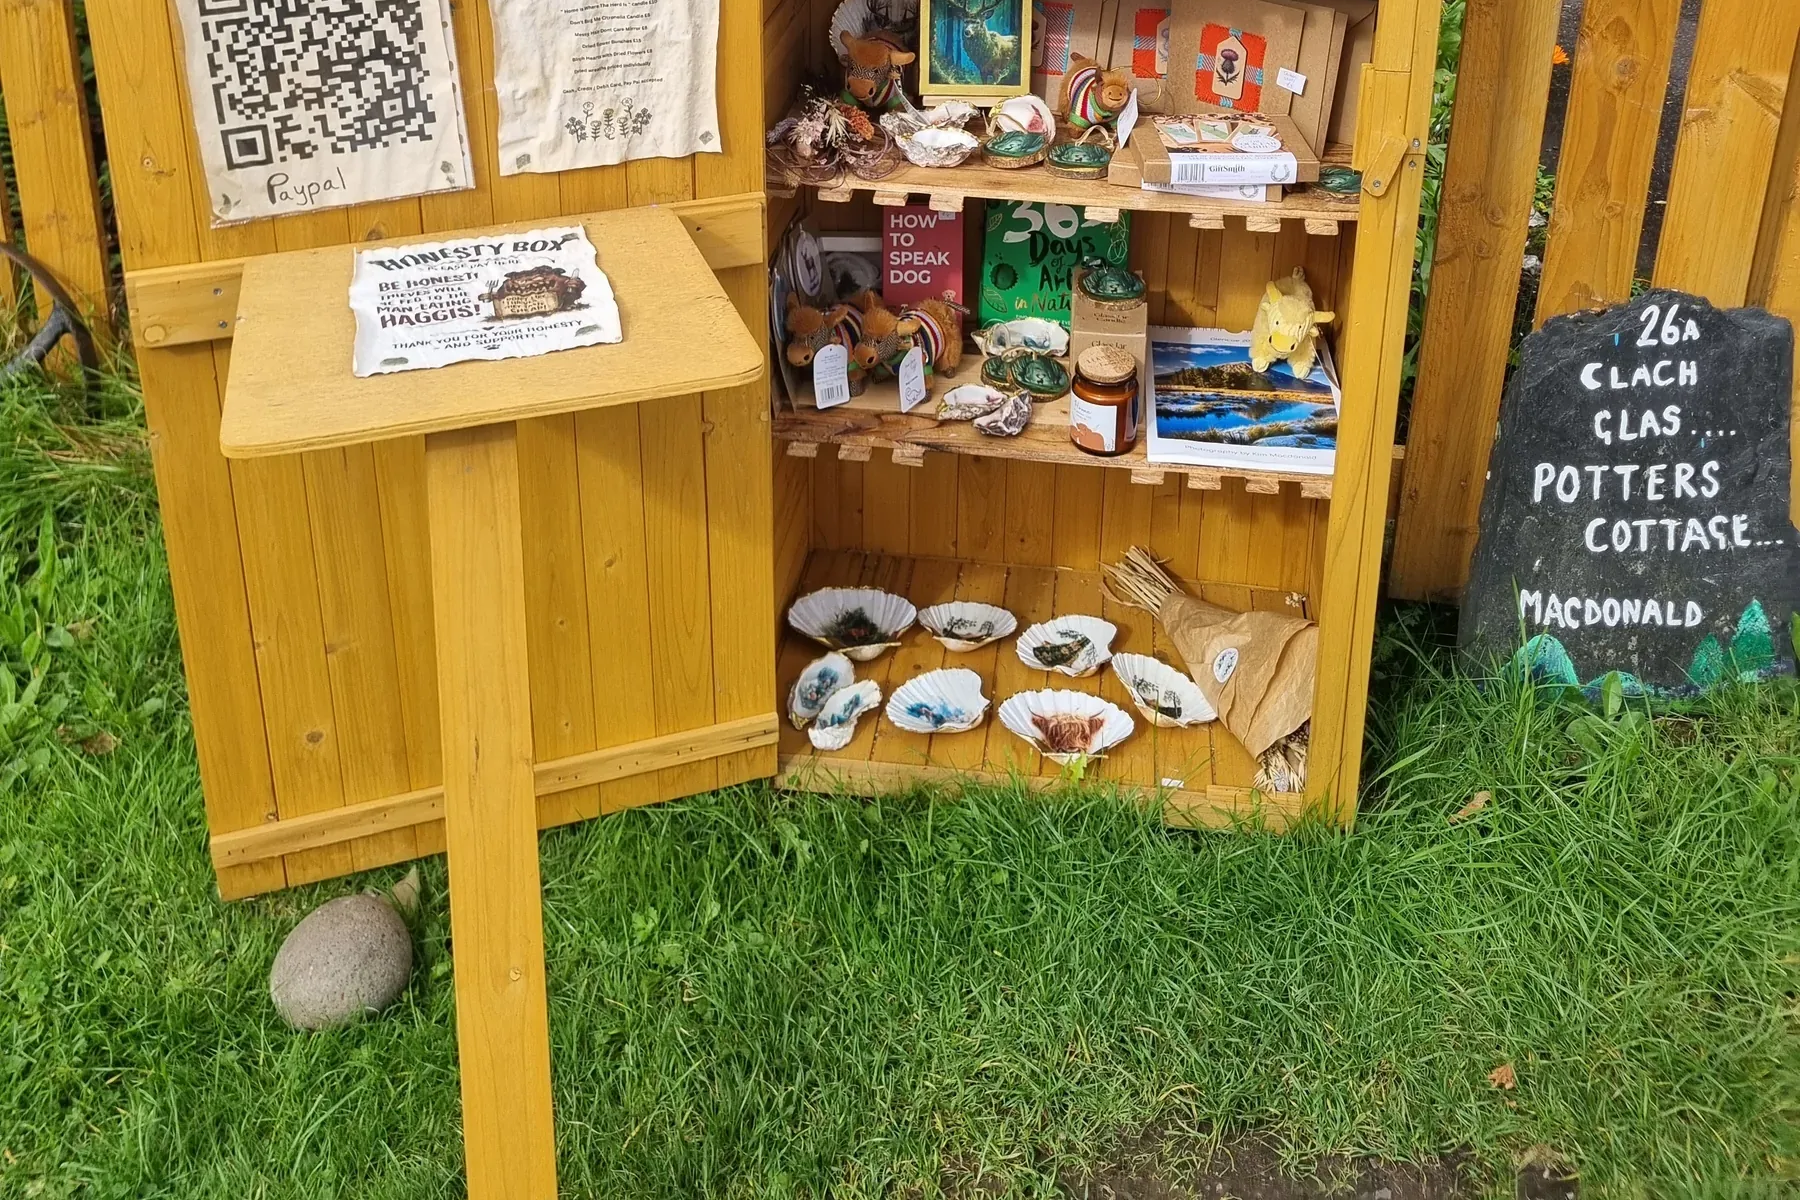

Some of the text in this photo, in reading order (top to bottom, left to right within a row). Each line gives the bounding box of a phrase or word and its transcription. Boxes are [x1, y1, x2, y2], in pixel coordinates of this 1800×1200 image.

[1209, 164, 1246, 174] GiftSmith
[266, 167, 347, 206] Paypal
[890, 214, 938, 228] HOW
[889, 232, 914, 247] TO
[1028, 230, 1096, 267] Days
[380, 240, 562, 271] HONESTY BOX
[889, 252, 950, 266] SPEAK
[1050, 256, 1066, 274] of
[378, 272, 479, 292] BE HONEST!
[890, 270, 931, 284] DOG
[380, 290, 430, 301] THIEVES
[1014, 297, 1028, 310] in
[377, 298, 472, 314] MAN-EATING
[380, 304, 481, 329] HAGGIS!
[1636, 304, 1701, 347] 26A
[392, 340, 432, 349] THANK
[491, 328, 523, 338] YOUR
[527, 320, 582, 334] HONESTY
[1580, 360, 1698, 390] CLACH
[1184, 444, 1238, 456] Photography
[1534, 460, 1721, 503] POTTERS
[1519, 588, 1703, 629] MACDONALD
